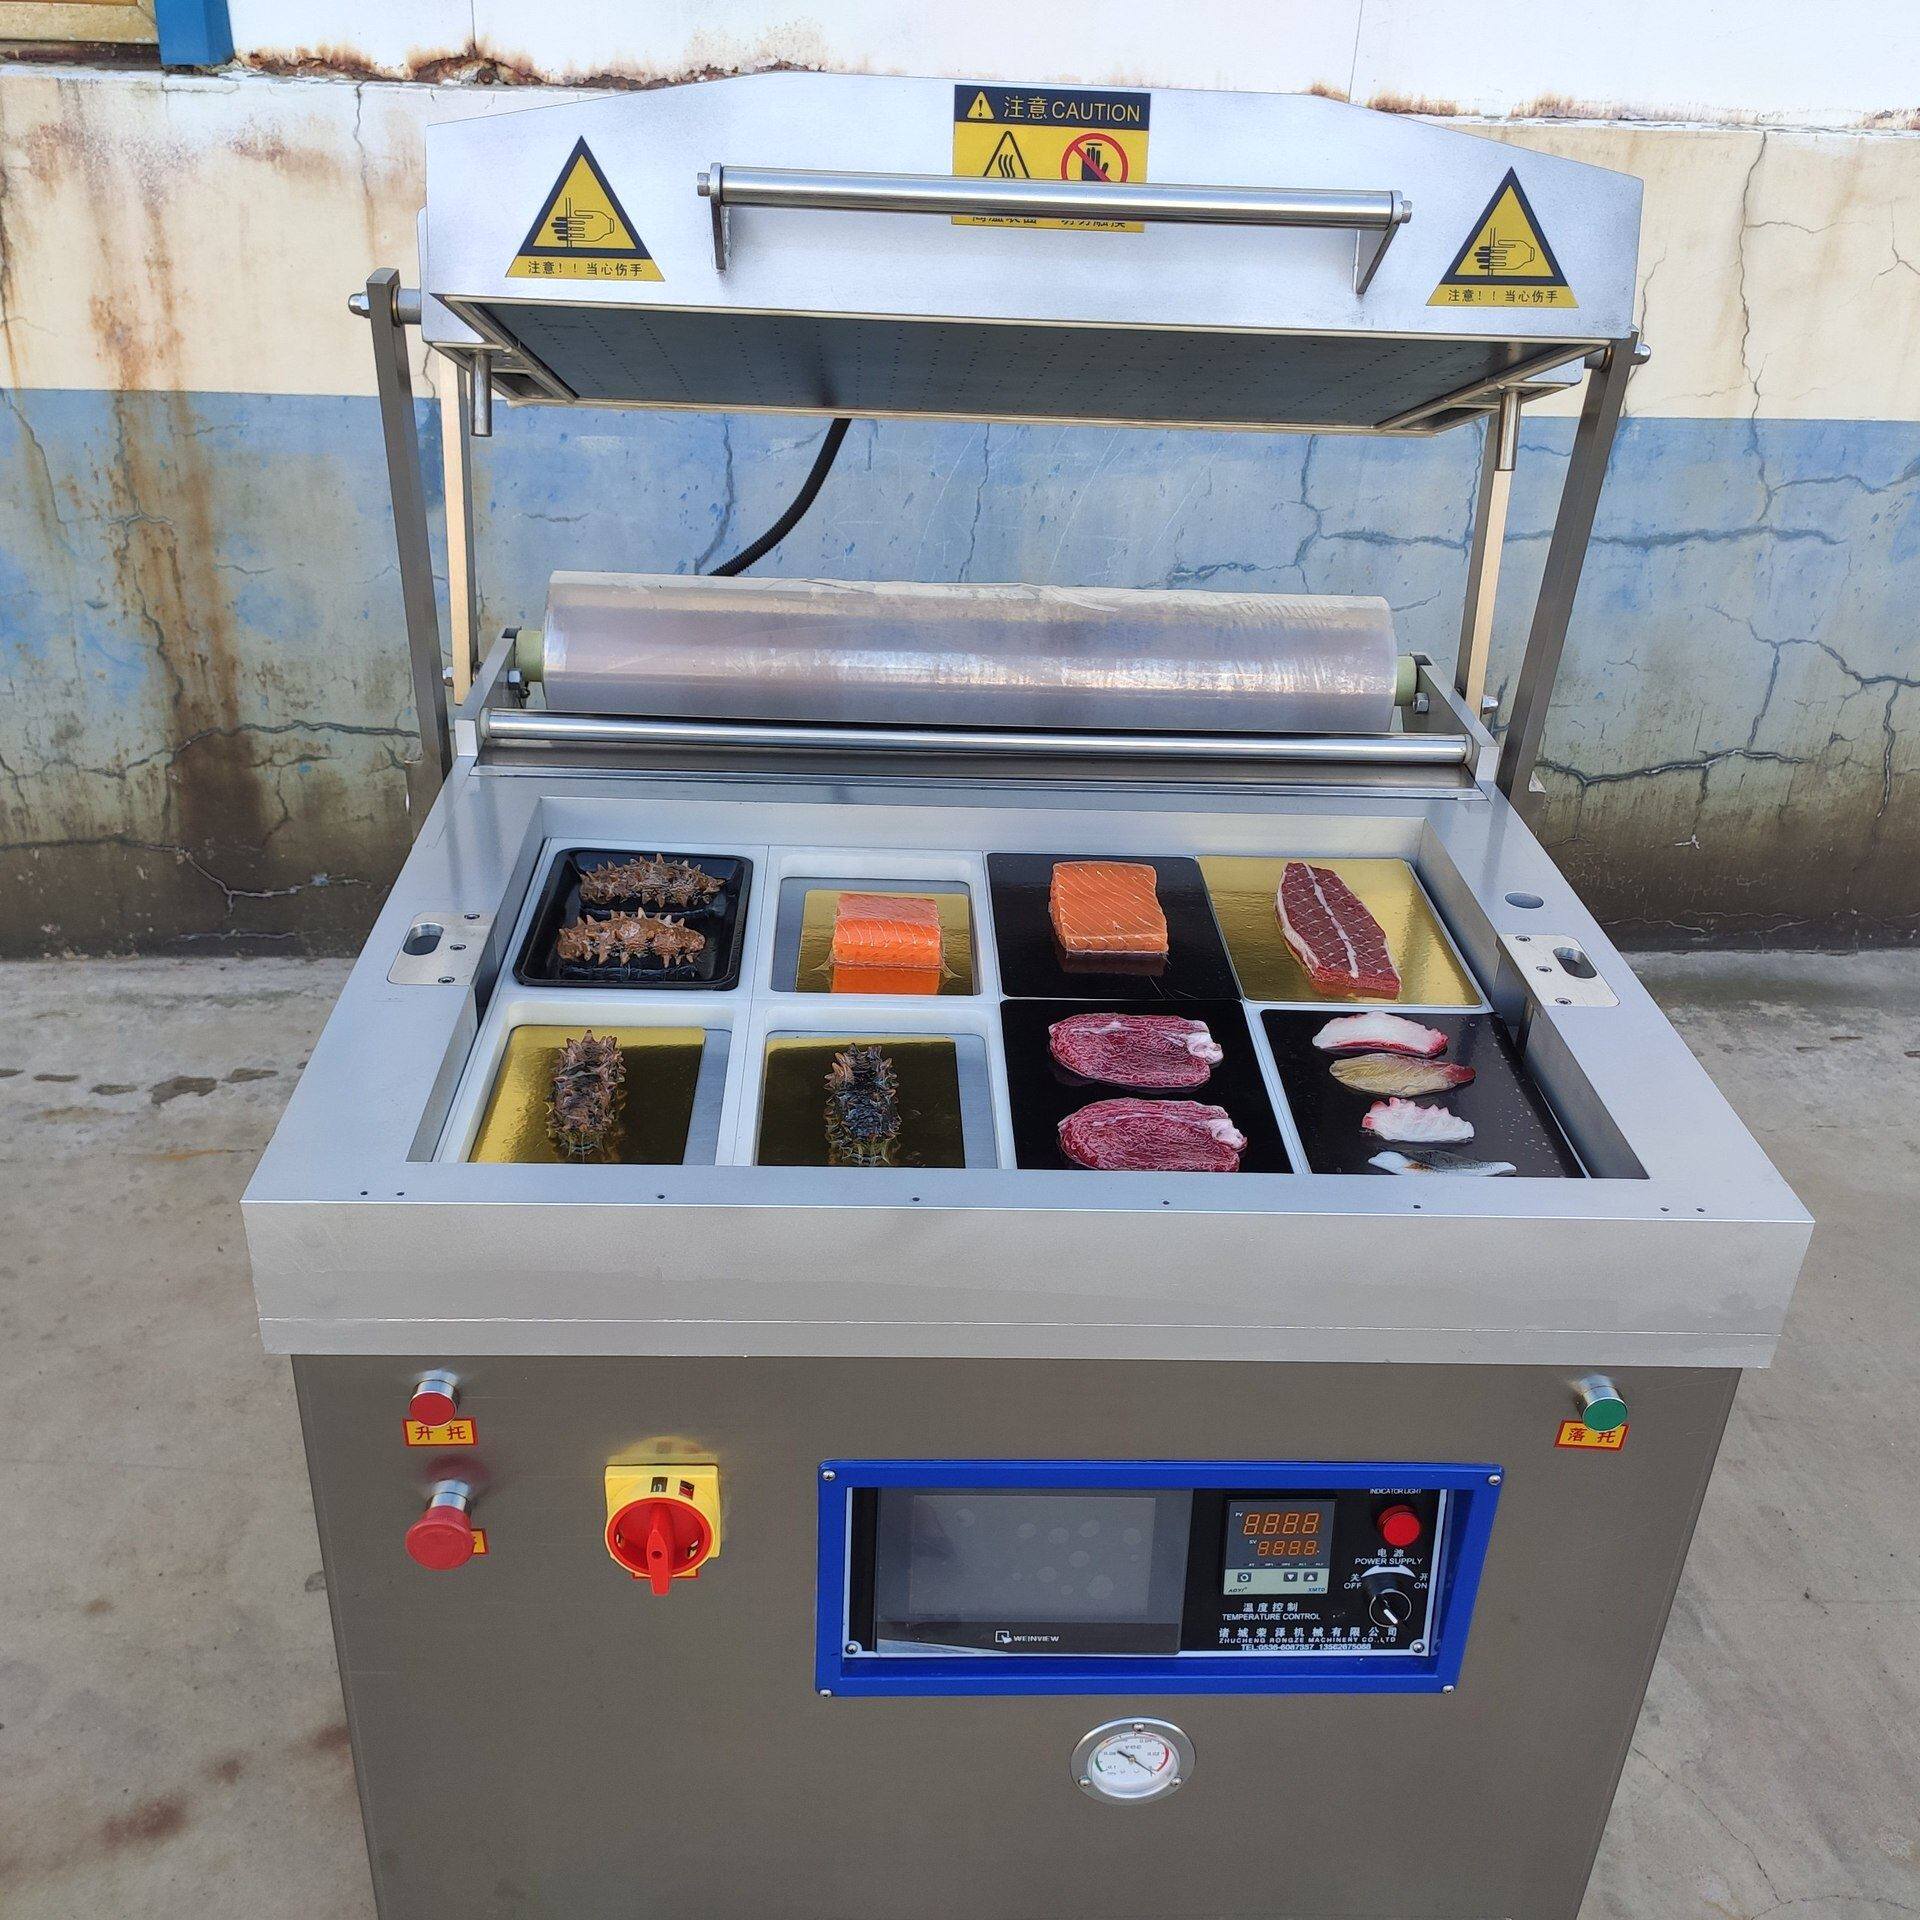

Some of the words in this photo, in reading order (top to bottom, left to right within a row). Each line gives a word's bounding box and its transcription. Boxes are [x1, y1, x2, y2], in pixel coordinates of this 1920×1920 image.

[1377, 1548, 1404, 1558] 电源
[1389, 1557, 1423, 1565] SUPPLY
[1419, 1572, 1429, 1581] 开
[1243, 1602, 1299, 1613] 温度控制
[1222, 1613, 1281, 1621] TEMPERATURE
[1282, 1613, 1321, 1621] CONTROL
